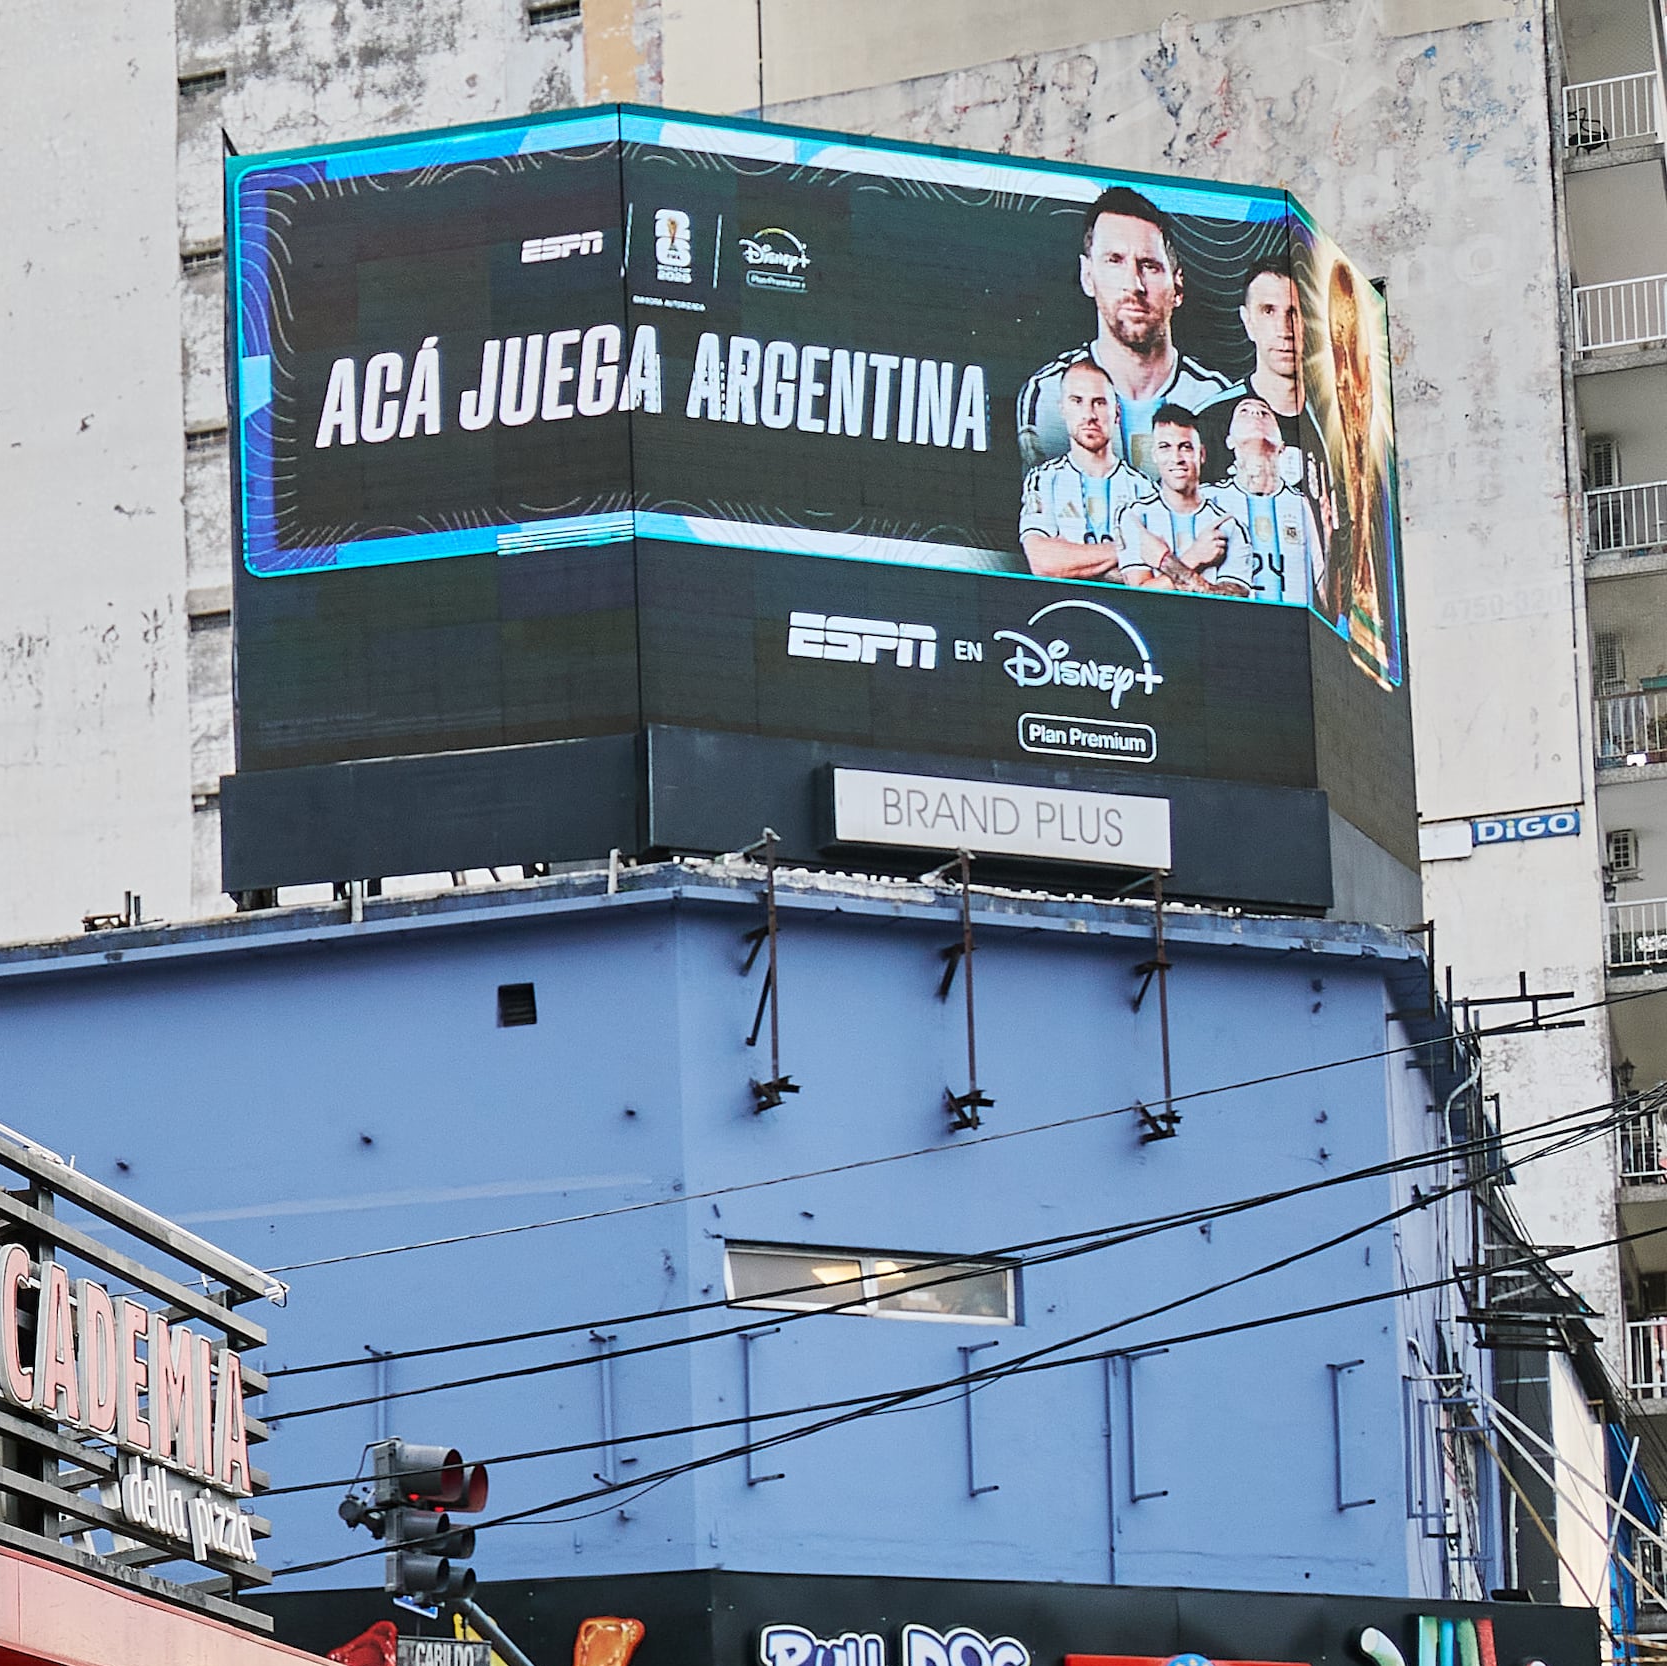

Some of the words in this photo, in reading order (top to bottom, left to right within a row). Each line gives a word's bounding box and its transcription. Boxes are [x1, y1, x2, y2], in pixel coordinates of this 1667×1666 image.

[520, 230, 604, 264] ESPN
[315, 335, 442, 449] ACÁ
[459, 323, 662, 432] JUEGA
[685, 332, 990, 453] ARGENTINA
[787, 610, 938, 671] ESPN
[953, 639, 984, 663] EN
[1028, 722, 1067, 746] Plan
[1069, 726, 1148, 754] Premium
[882, 786, 1021, 837] BRAND
[1036, 800, 1125, 848] PLUS
[121, 1456, 187, 1538] della
[188, 1487, 257, 1562] pizza
